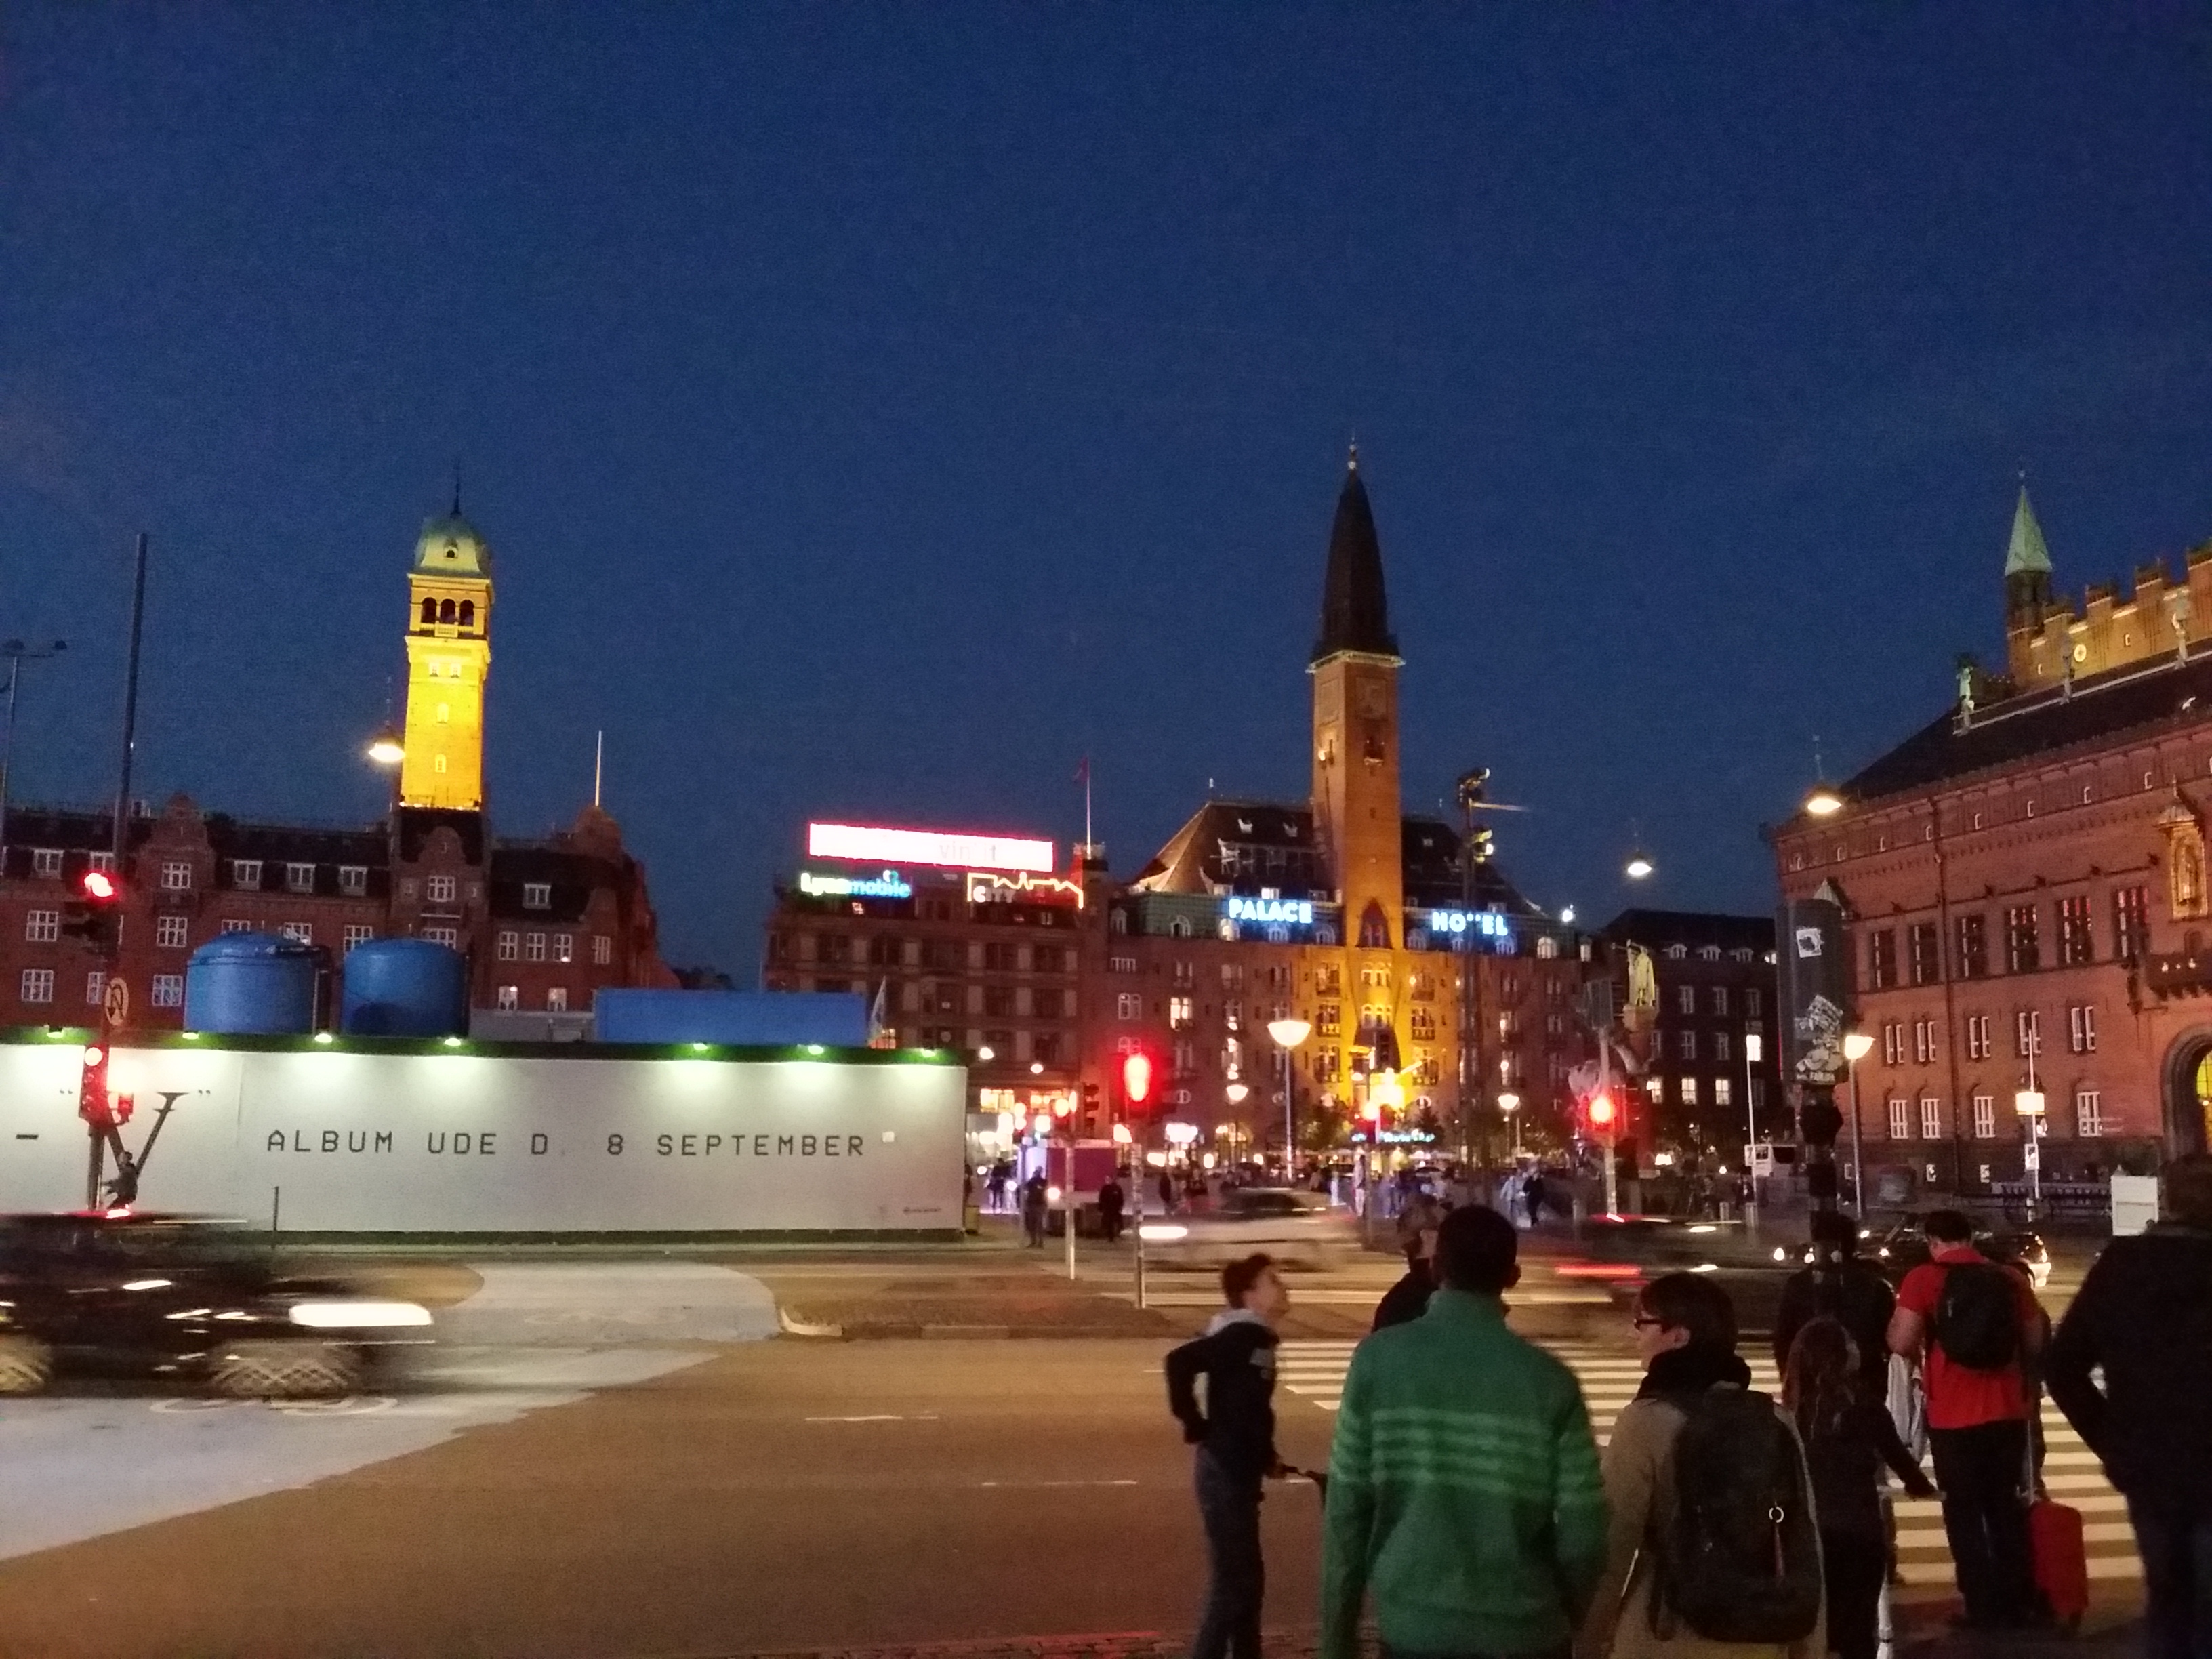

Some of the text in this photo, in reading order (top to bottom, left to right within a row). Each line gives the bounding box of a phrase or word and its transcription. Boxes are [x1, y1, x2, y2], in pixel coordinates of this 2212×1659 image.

[973, 886, 1016, 903] CITY
[1229, 899, 1312, 923] PALACE
[268, 1130, 392, 1153] ALBUM
[428, 1132, 496, 1154] UDE
[607, 1134, 623, 1155] 8
[657, 1134, 863, 1155] SEPTEMBER
